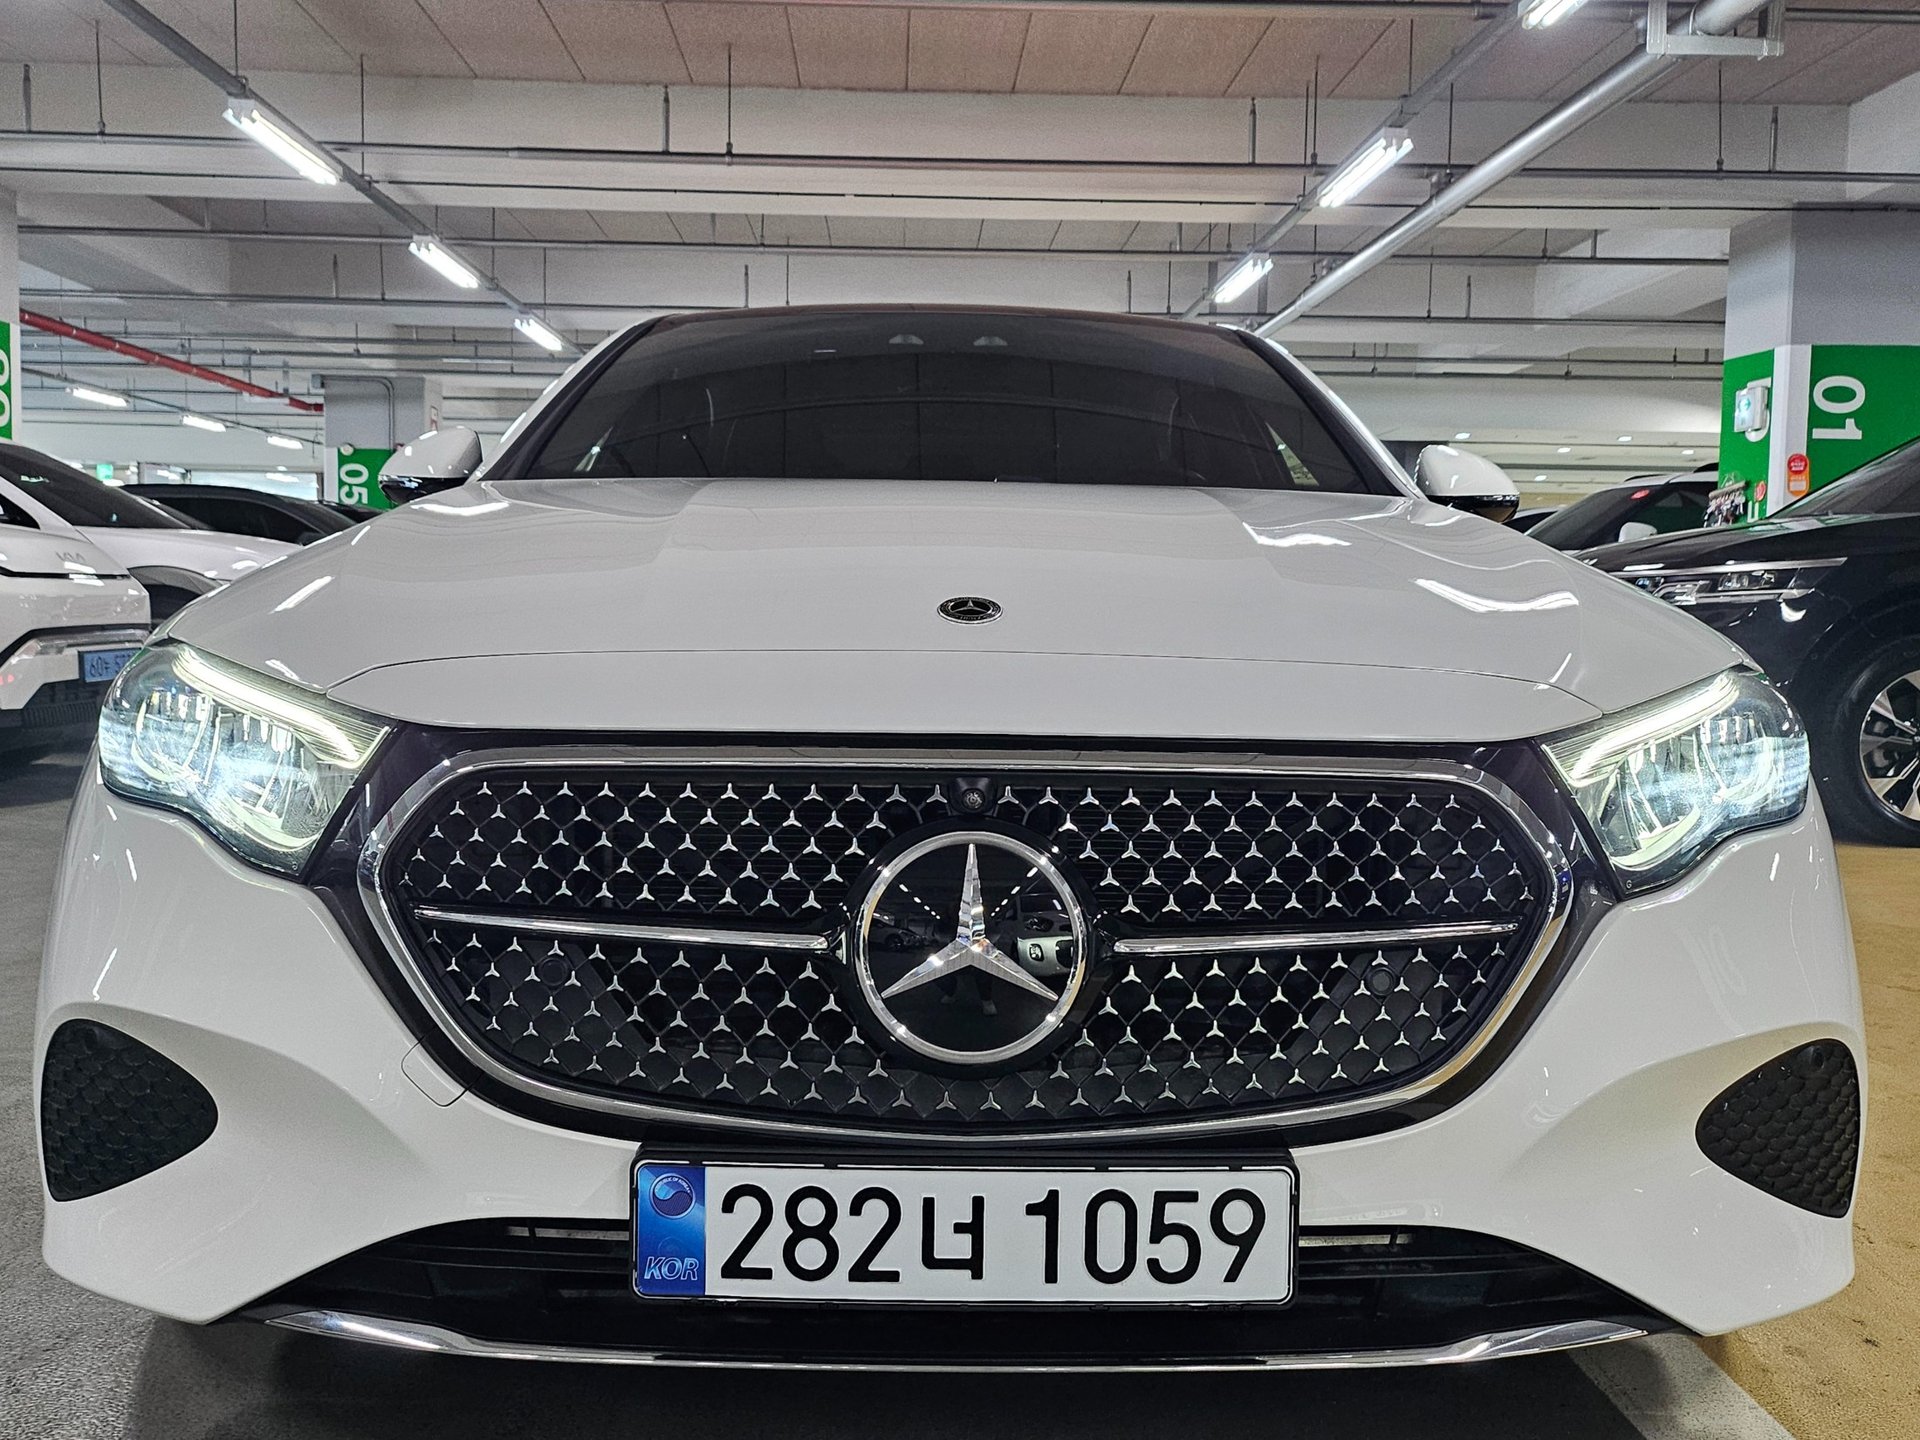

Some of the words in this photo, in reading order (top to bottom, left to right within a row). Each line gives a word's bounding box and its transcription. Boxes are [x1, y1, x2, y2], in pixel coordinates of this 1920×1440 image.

[1812, 375, 1867, 440] 01
[339, 462, 369, 505] 05
[720, 1183, 985, 1283] 282너
[1025, 1188, 1266, 1285] 1059
[644, 1256, 700, 1280] KOR
